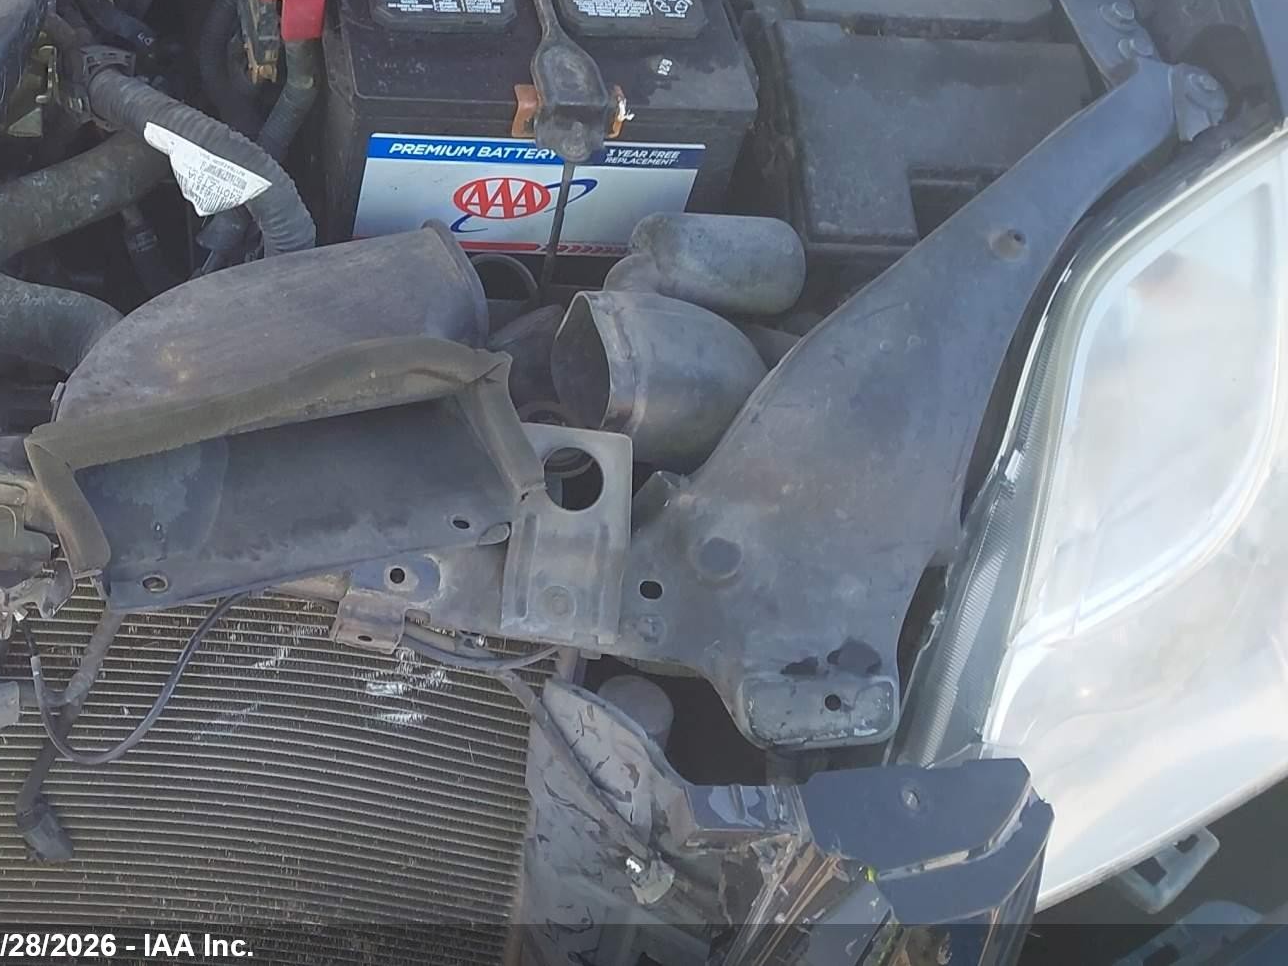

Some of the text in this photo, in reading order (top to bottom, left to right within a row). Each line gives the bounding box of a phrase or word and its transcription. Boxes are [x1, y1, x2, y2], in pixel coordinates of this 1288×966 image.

[389, 143, 557, 161] PREMIUM BATTERY
[607, 149, 681, 159] 3 YEAR FREE
[463, 178, 539, 219] AAA
